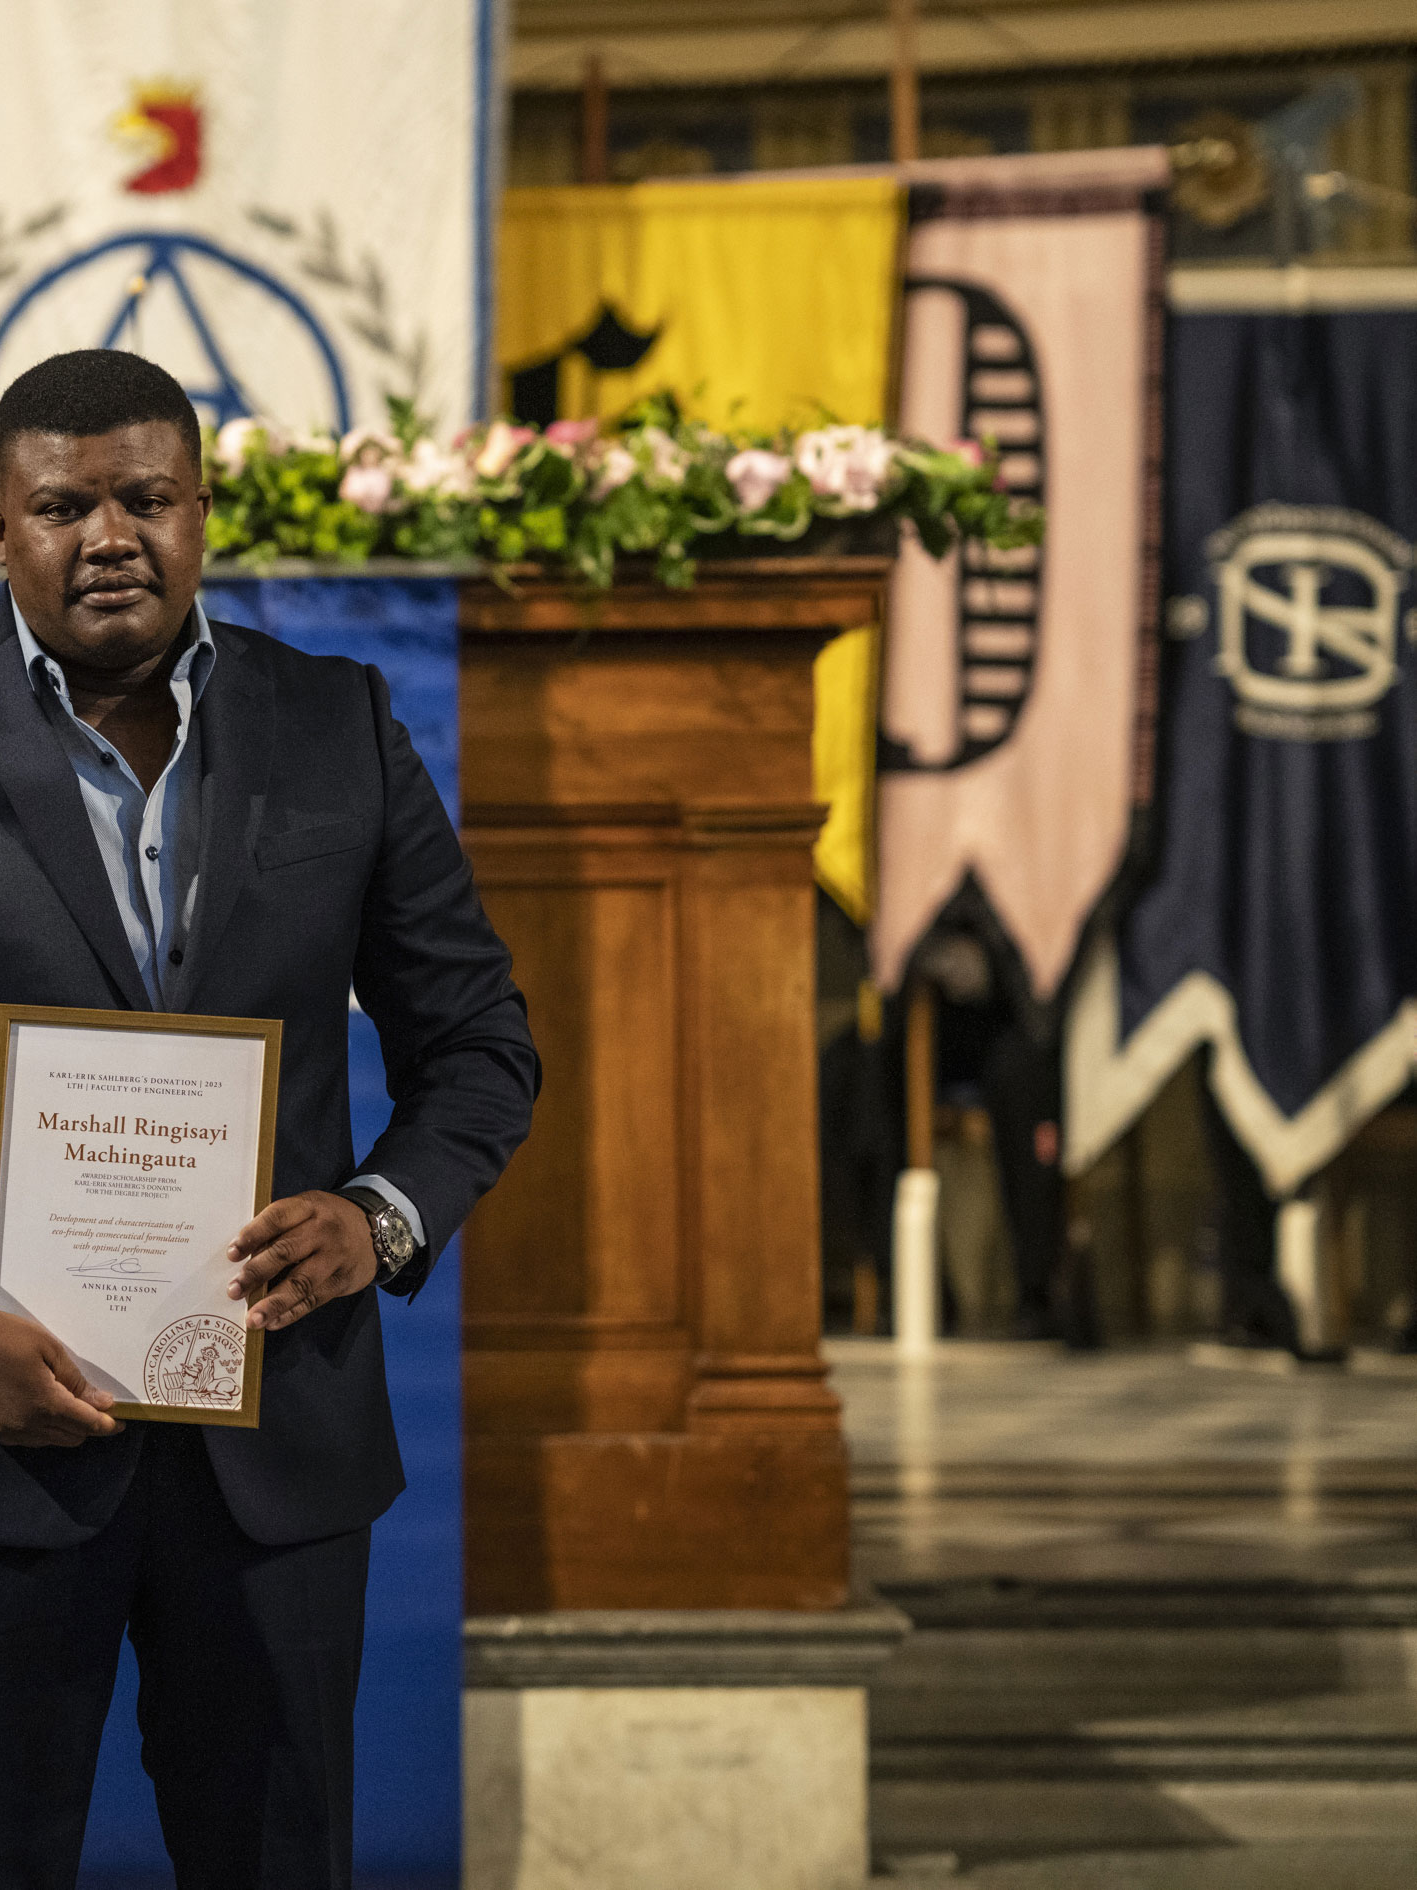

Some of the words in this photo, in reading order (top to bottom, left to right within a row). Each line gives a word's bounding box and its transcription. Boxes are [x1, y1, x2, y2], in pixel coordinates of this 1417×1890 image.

[49, 1071, 96, 1081] KARL-ERIK
[150, 1077, 197, 1087] DONATION
[67, 1082, 84, 1090] LTH
[91, 1084, 129, 1093] FACULTY
[144, 1087, 203, 1097] ENGINEERING
[37, 1111, 126, 1135] Marshall
[134, 1117, 228, 1146] Ringisayi
[64, 1142, 197, 1172] Machingauta
[81, 1172, 112, 1180] AWARDED
[113, 1175, 157, 1183] SCHOLARSHIP
[147, 1184, 182, 1192] DONATION
[49, 1213, 97, 1225] Development
[98, 1217, 114, 1225] and
[115, 1218, 174, 1229] characterization
[175, 1221, 186, 1232] of
[52, 1228, 94, 1239] eco-friendly
[96, 1232, 145, 1240] cosmeceutical
[144, 1232, 190, 1244] formulation
[73, 1242, 90, 1250] with
[92, 1244, 122, 1253] optimal
[121, 1245, 167, 1255] performance
[82, 1283, 117, 1291] ANNIKA
[121, 1285, 158, 1294] OLSSON
[106, 1294, 132, 1302] DEAN
[166, 1346, 178, 1362] AD
